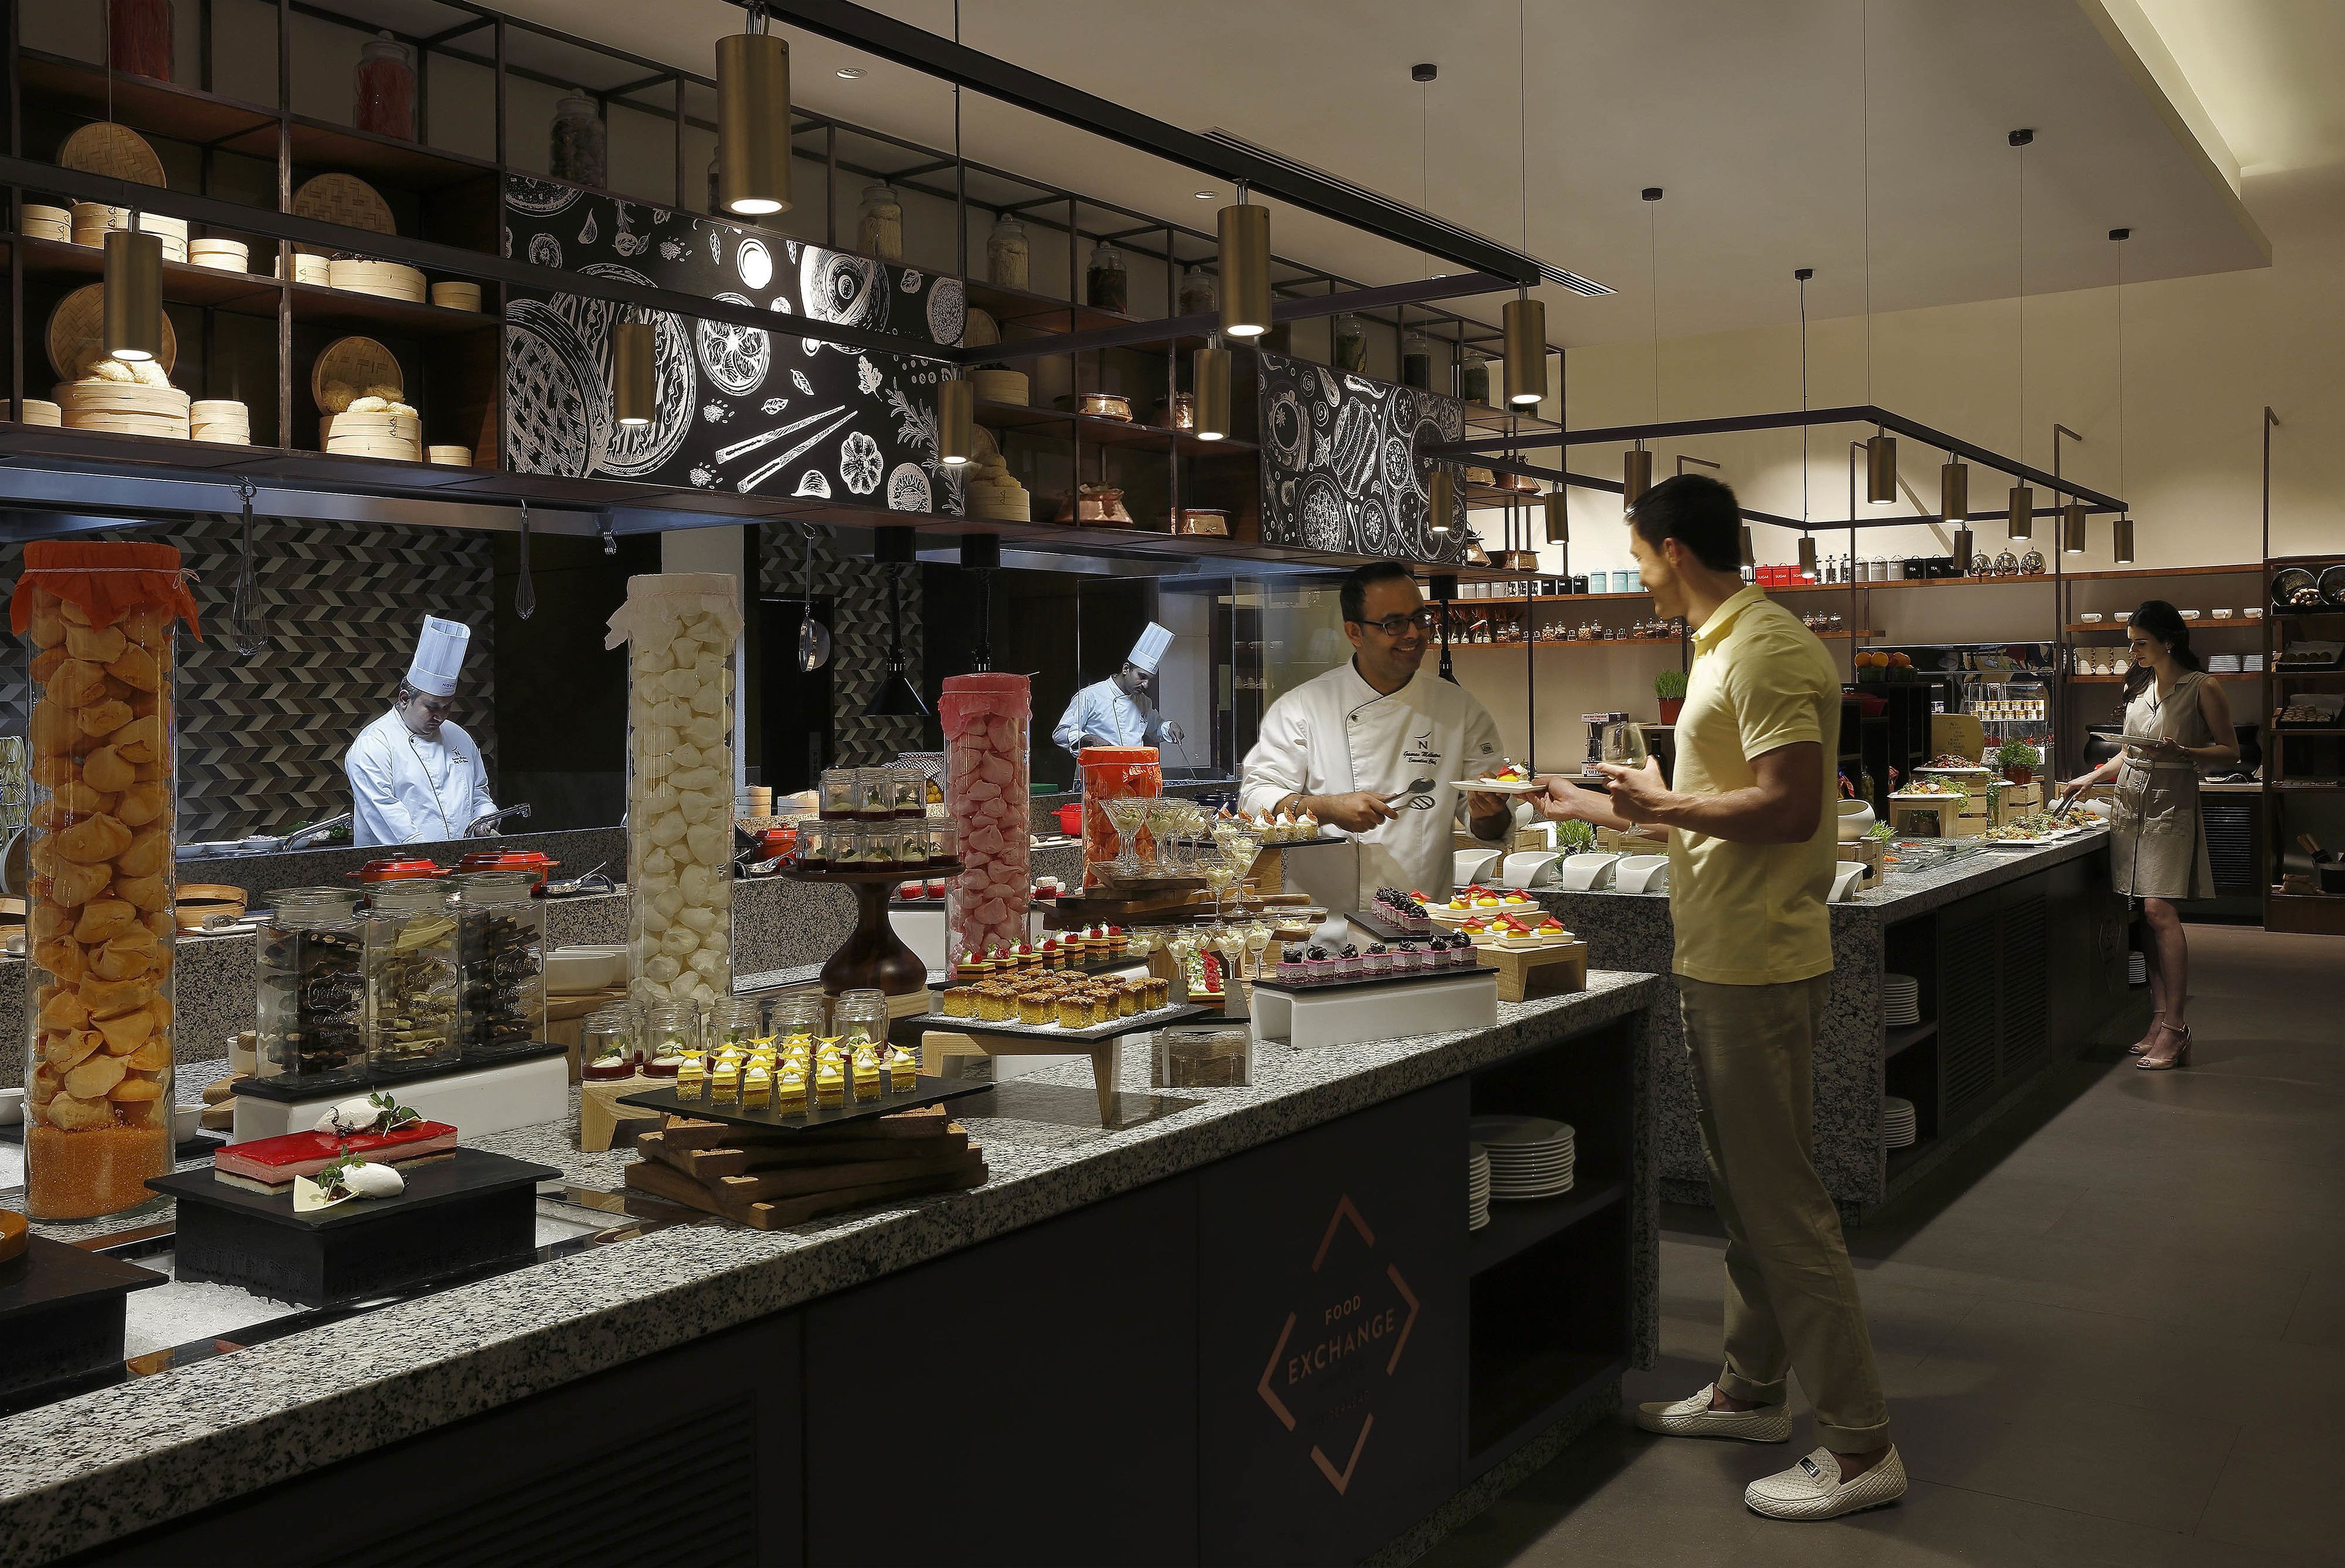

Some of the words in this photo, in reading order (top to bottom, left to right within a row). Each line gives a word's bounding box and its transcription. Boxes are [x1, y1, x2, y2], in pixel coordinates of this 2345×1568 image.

[1418, 741, 1428, 749] N
[1324, 1295, 1362, 1326] FOOD
[1288, 1309, 1395, 1385] EXCHANGE
